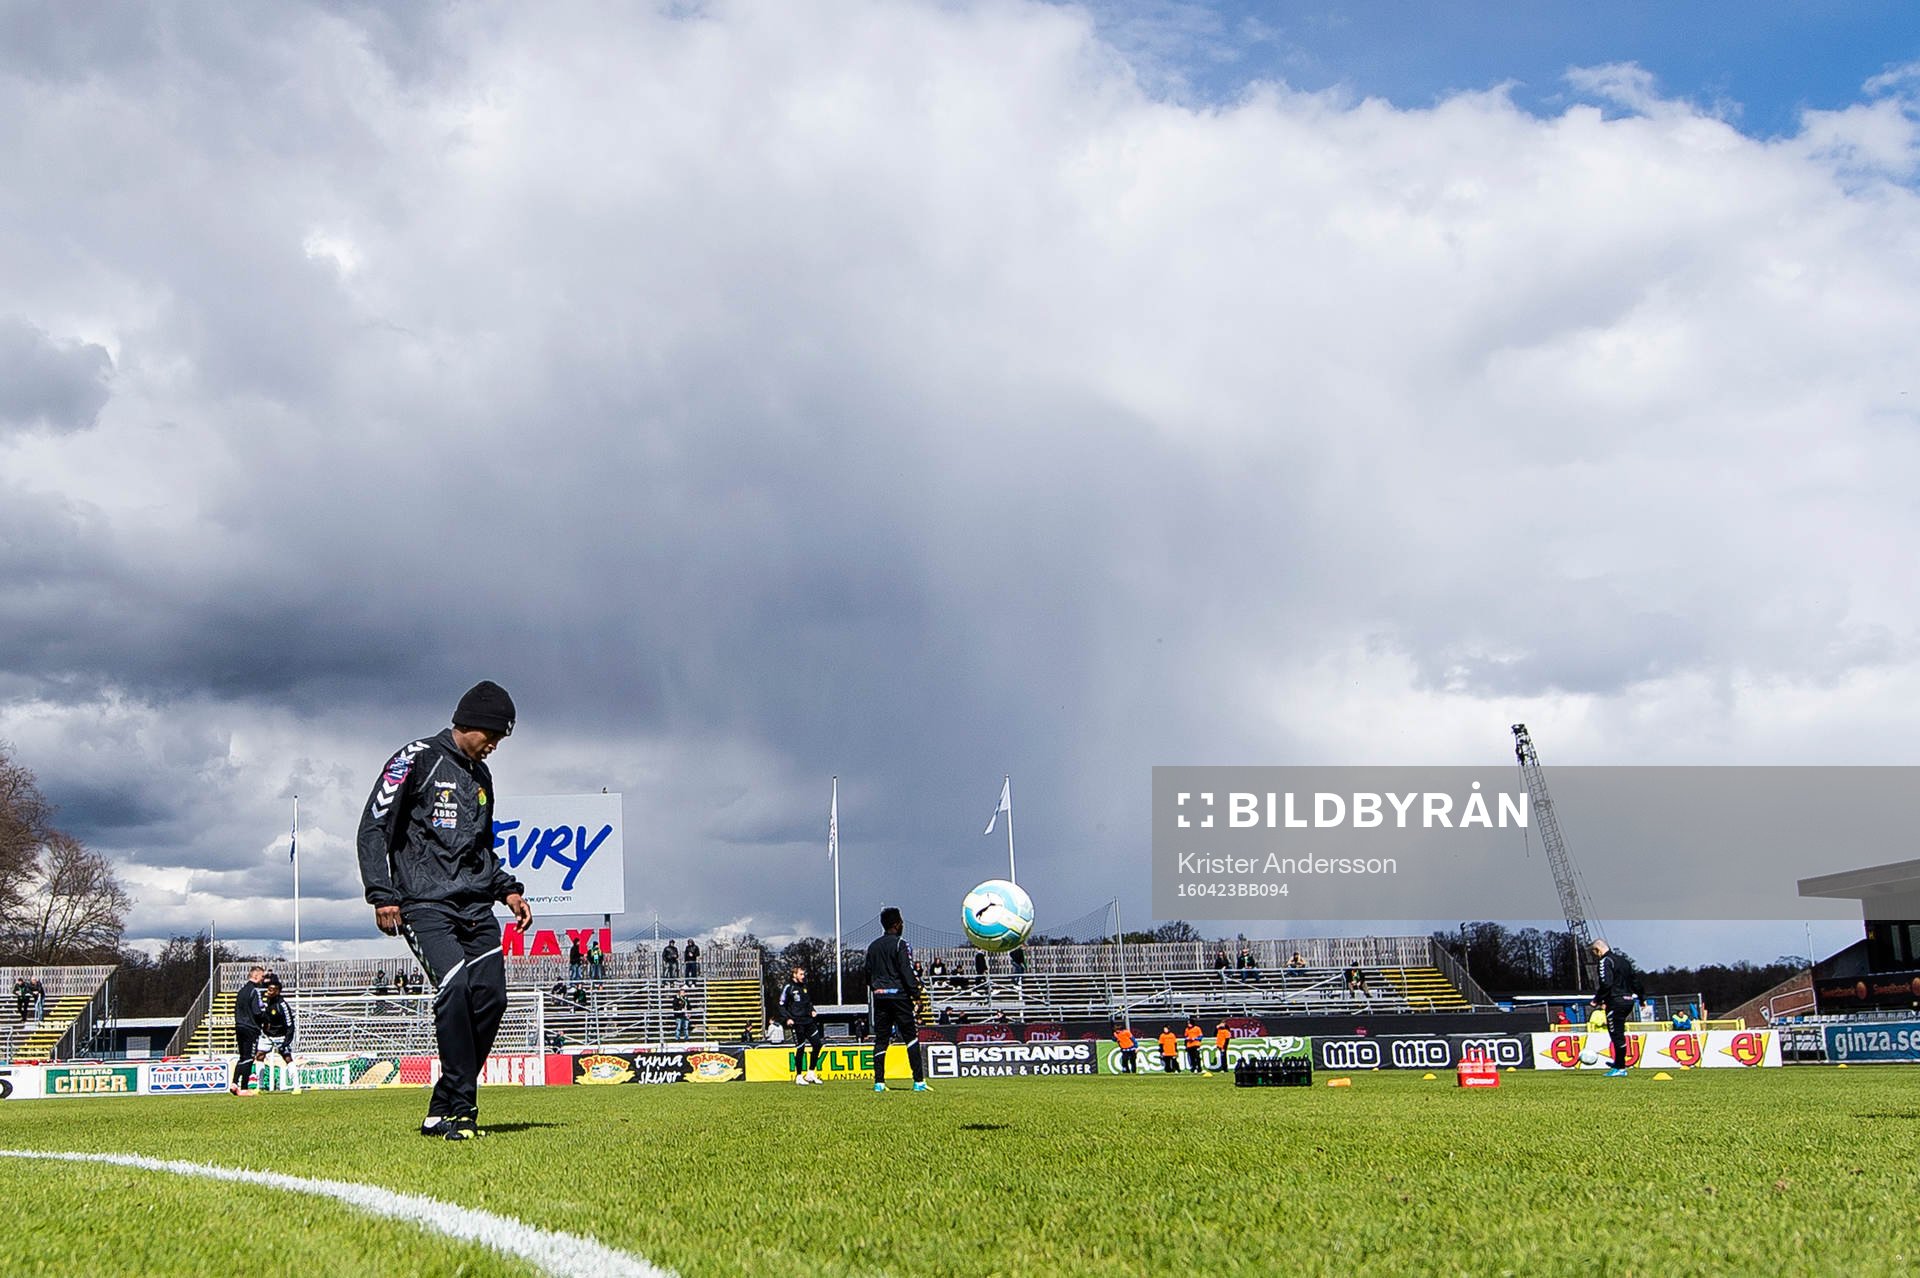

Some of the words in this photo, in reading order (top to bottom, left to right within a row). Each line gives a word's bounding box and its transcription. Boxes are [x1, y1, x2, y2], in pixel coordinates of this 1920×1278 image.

[492, 819, 613, 892] EVRY
[525, 895, 573, 904] w.evry.com
[1835, 1027, 1920, 1059] ginza.se
[633, 1054, 684, 1069] tunna
[960, 1045, 1090, 1062] EKSTRANDS
[153, 1073, 184, 1083] THREE
[186, 1071, 225, 1082] HEARTS
[638, 1065, 682, 1085] skivor
[961, 1063, 1013, 1077] DÖRRAR
[1019, 1065, 1028, 1076] &
[1034, 1063, 1092, 1075] FÖNSTER
[55, 1075, 128, 1093] CIDER
